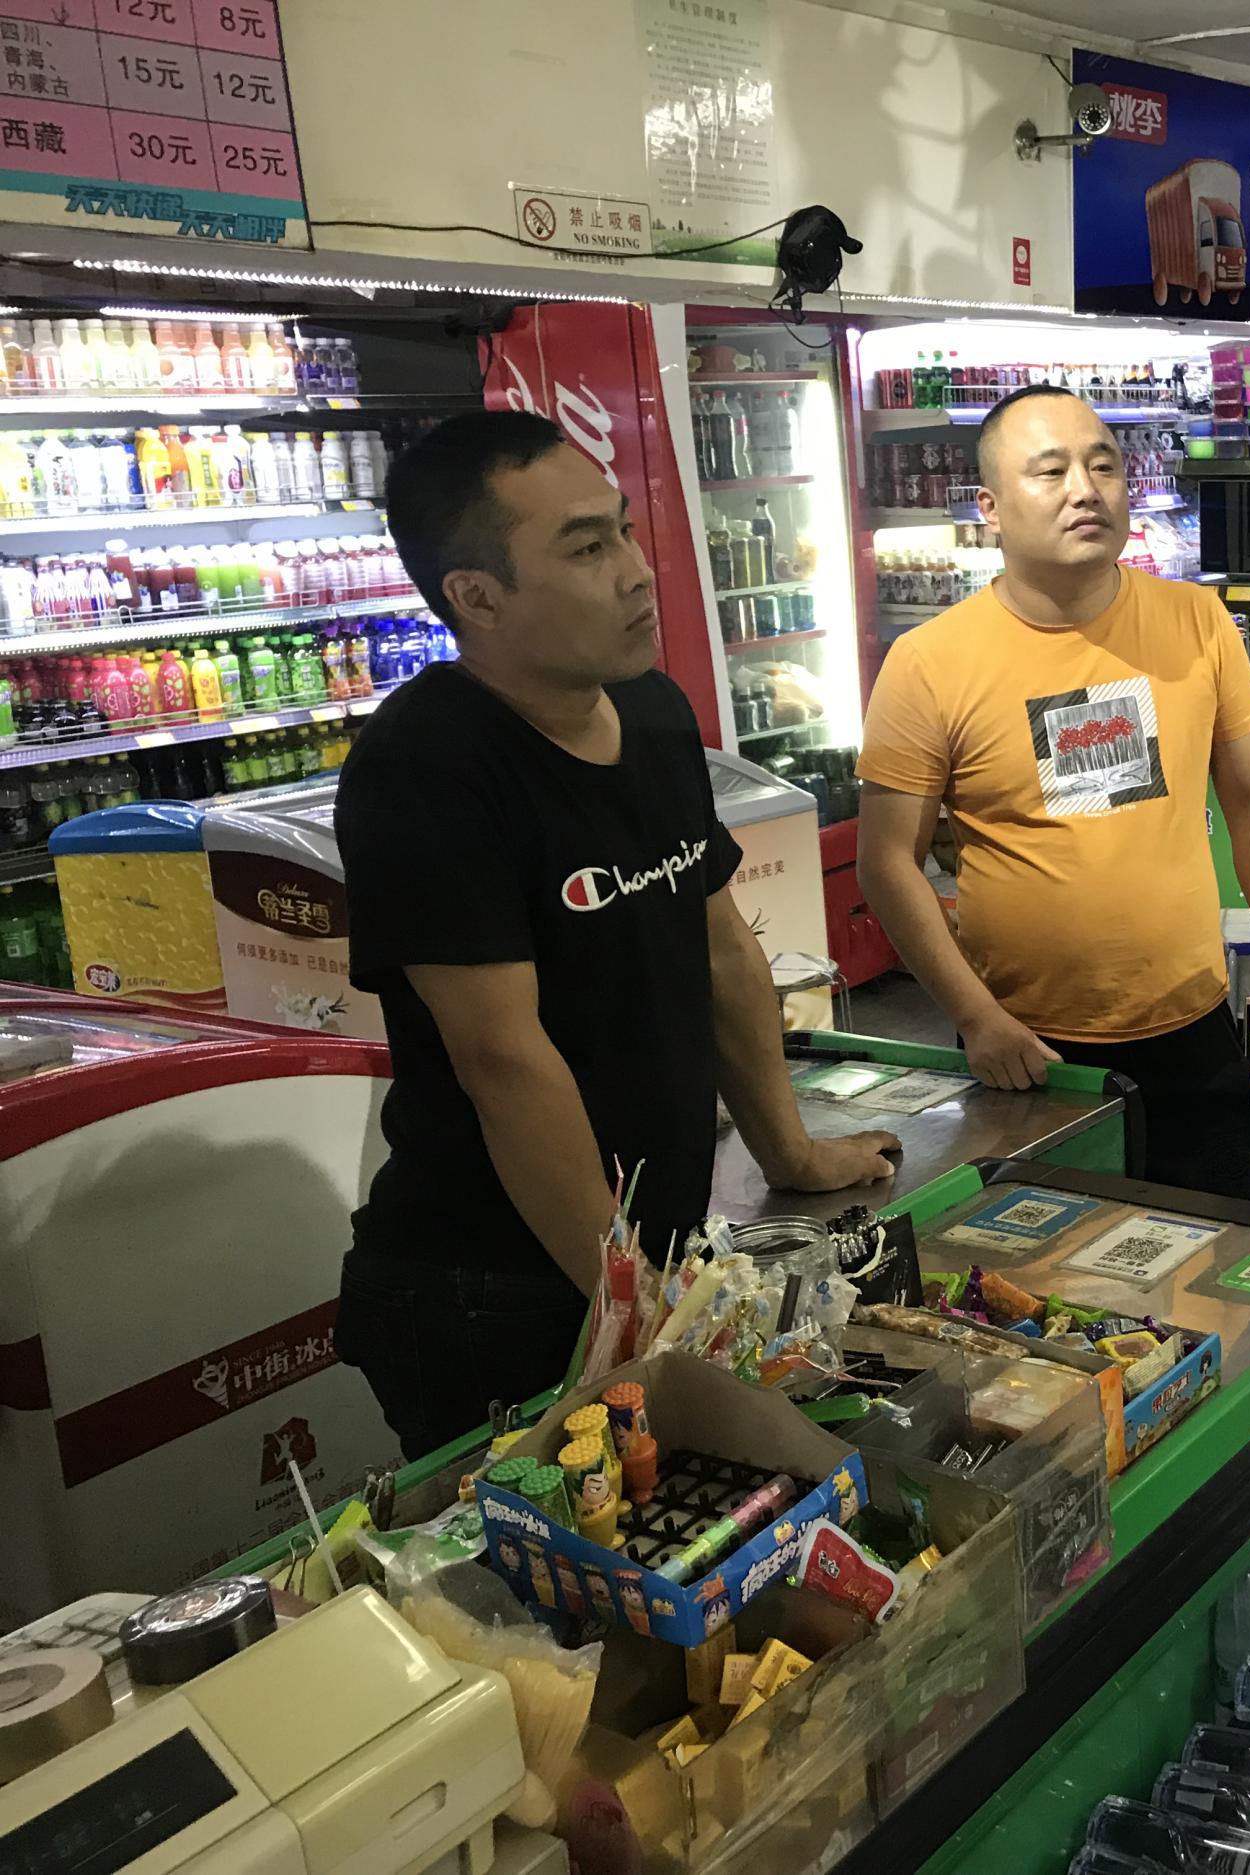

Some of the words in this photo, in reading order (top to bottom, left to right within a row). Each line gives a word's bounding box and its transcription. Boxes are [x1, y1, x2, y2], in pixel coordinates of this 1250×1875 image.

[219, 7, 266, 38] 8元
[8, 72, 70, 97] 内蒙古
[118, 56, 184, 90] 15元
[214, 72, 276, 105] 12元
[1108, 92, 1163, 136] 桃李
[0, 118, 66, 154] 西藏
[128, 132, 197, 166] 30元
[223, 145, 288, 177] 25元
[65, 184, 184, 221] 天天快递
[569, 206, 642, 232] 禁止吸烟
[573, 232, 589, 245] NO
[591, 234, 640, 250] SMOKING
[727, 859, 785, 887] 自然完美
